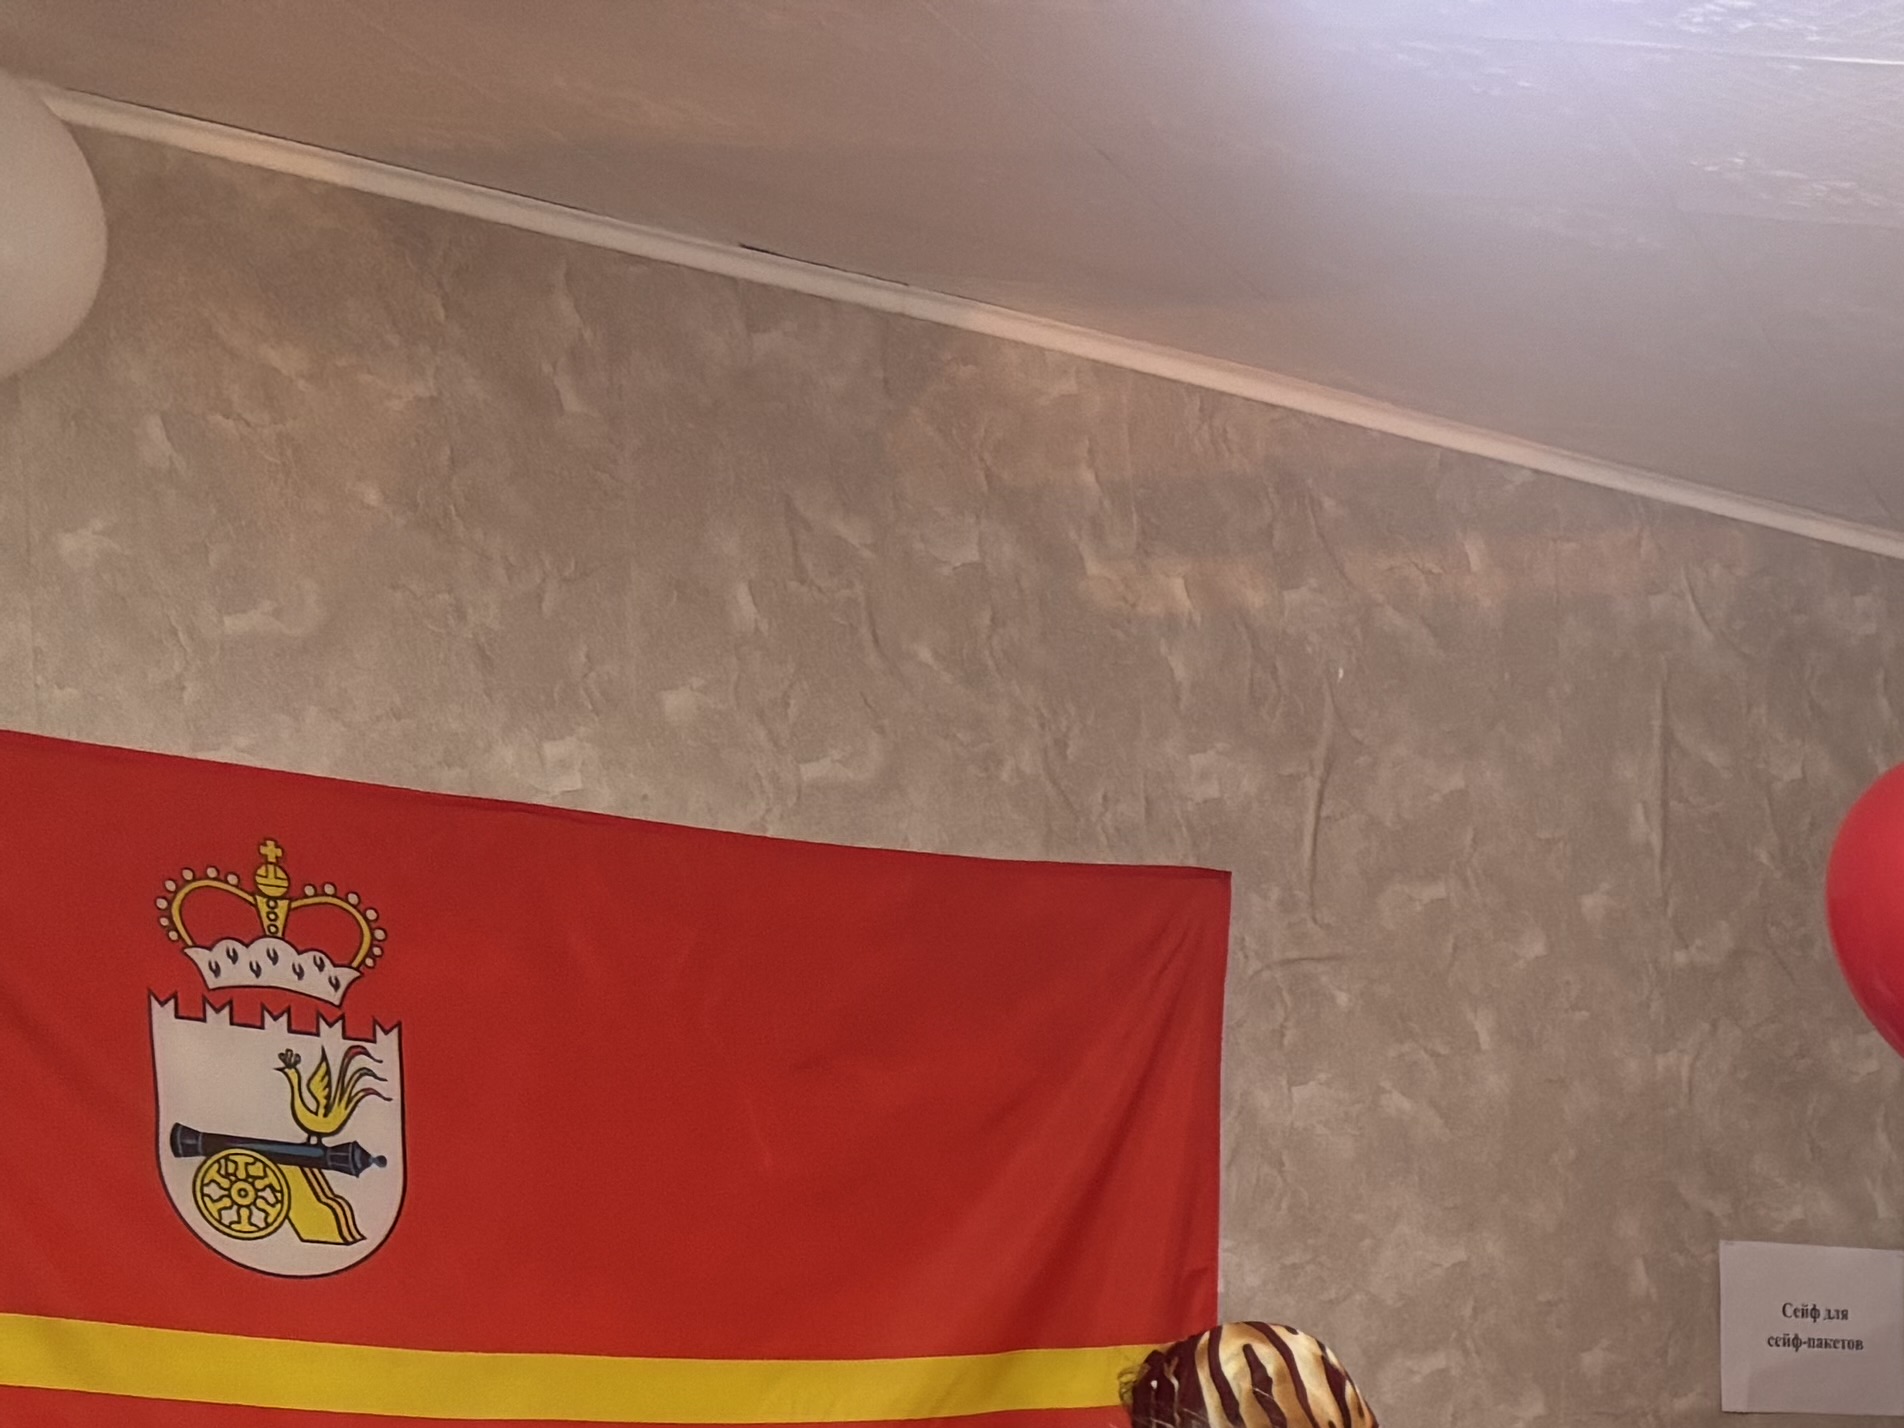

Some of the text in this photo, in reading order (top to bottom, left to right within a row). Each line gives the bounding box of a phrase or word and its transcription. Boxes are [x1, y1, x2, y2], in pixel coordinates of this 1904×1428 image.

[1782, 1302, 1849, 1323] Сейф для
[1767, 1333, 1864, 1352] сейф-пакетов
